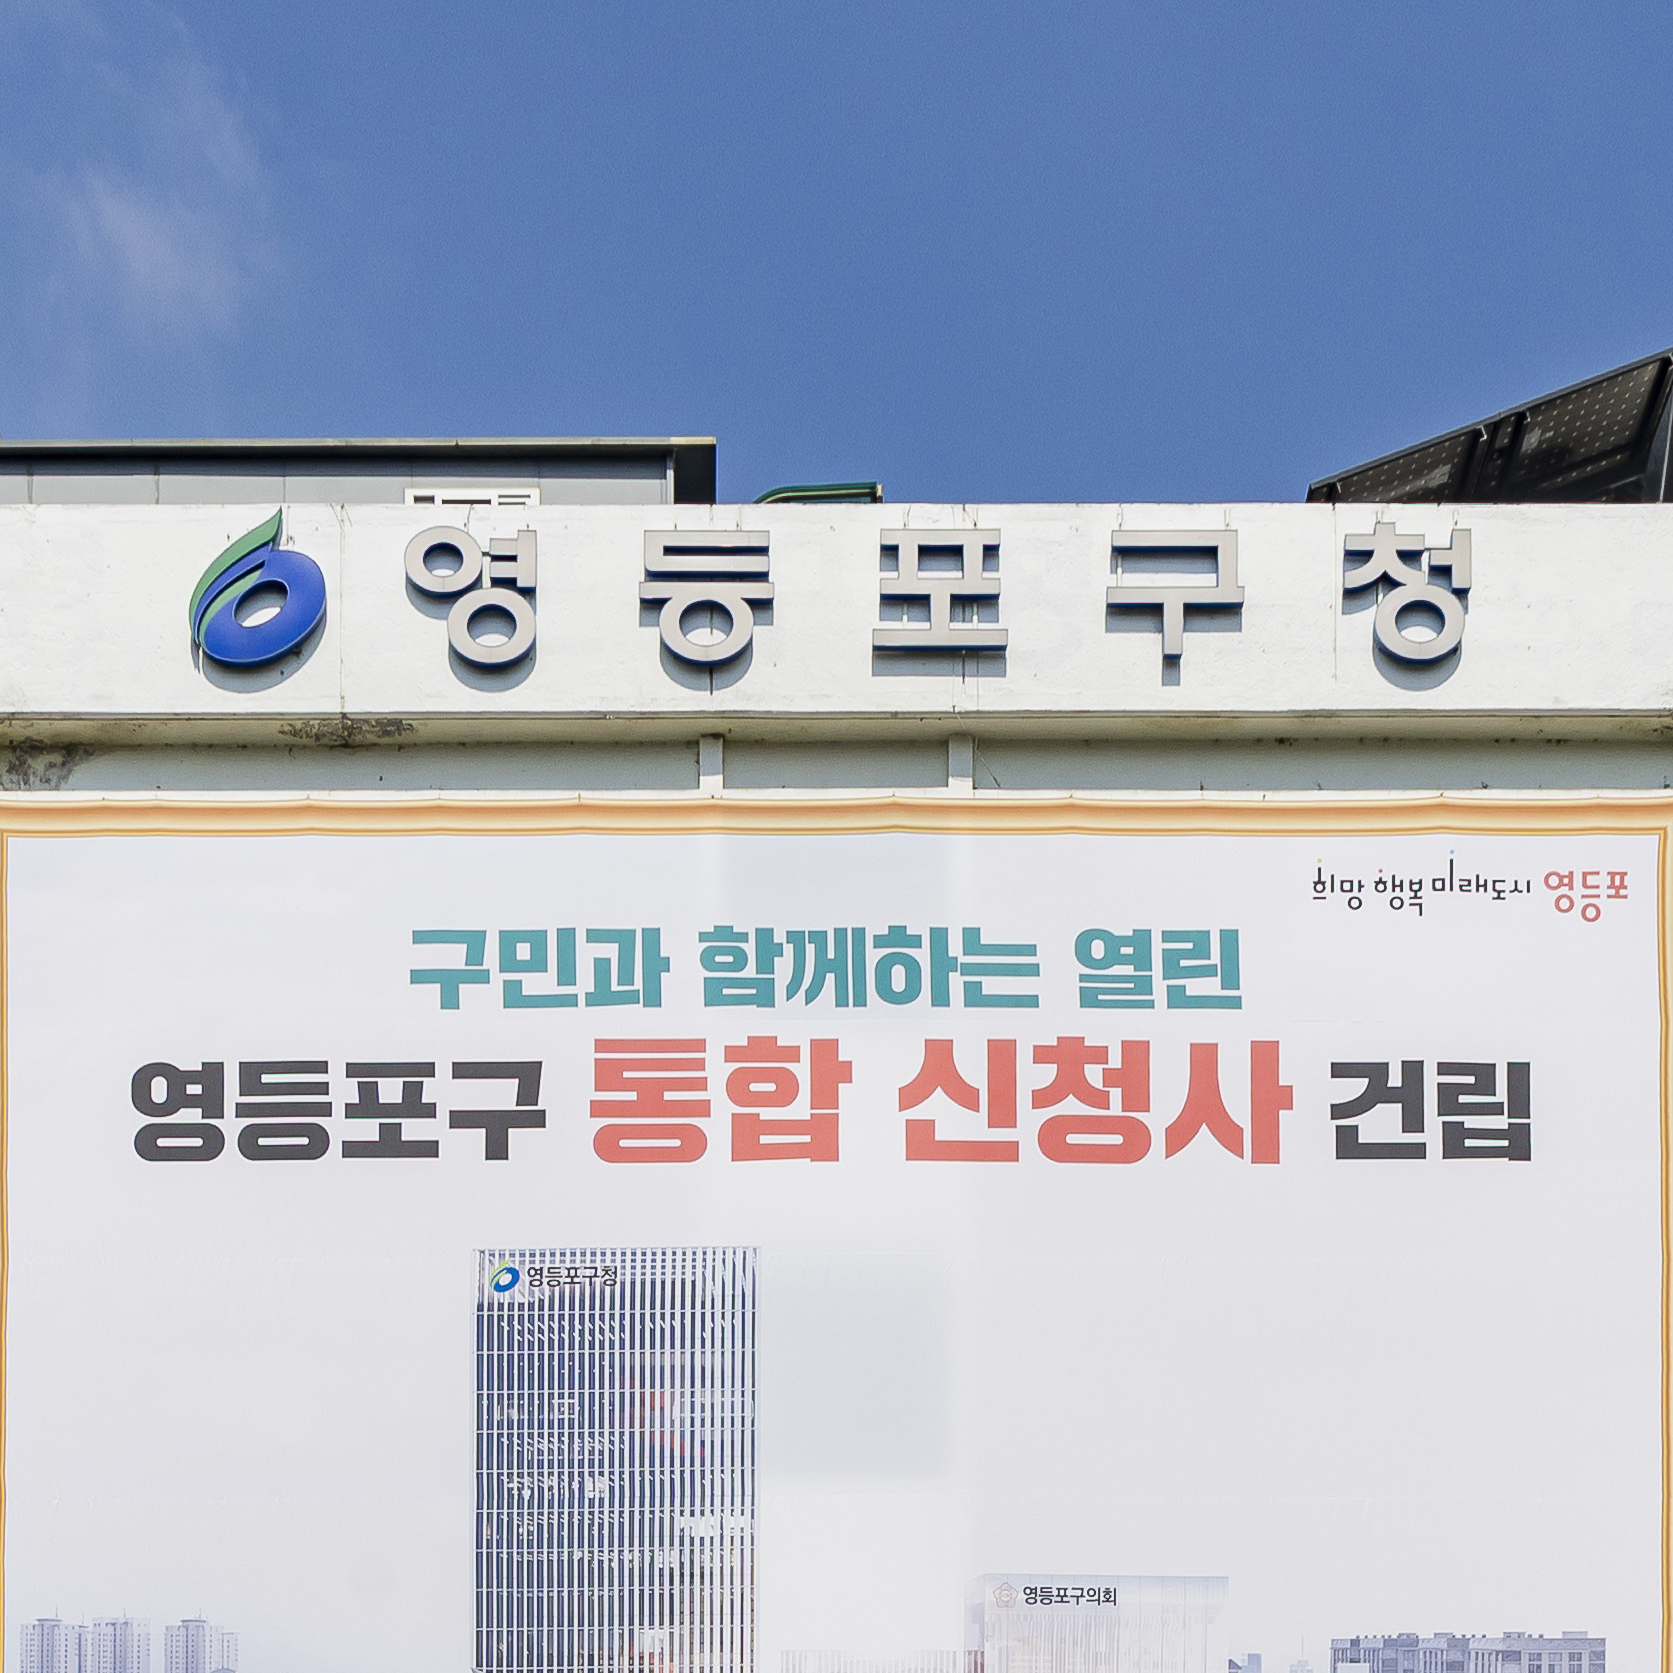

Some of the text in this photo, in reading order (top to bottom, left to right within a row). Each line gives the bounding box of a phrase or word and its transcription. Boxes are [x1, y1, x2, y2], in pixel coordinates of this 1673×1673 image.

[404, 522, 1472, 668] 영등포구청
[1312, 849, 1629, 923] 희망 행복 미래도시 영등포
[408, 927, 1243, 1010] 구민과 함께하는 열린
[129, 1036, 1533, 1165] 영등포구 통합 신청사 건립
[526, 1264, 619, 1288] 영등포구청
[1022, 1584, 1118, 1608] 영등포구의회
